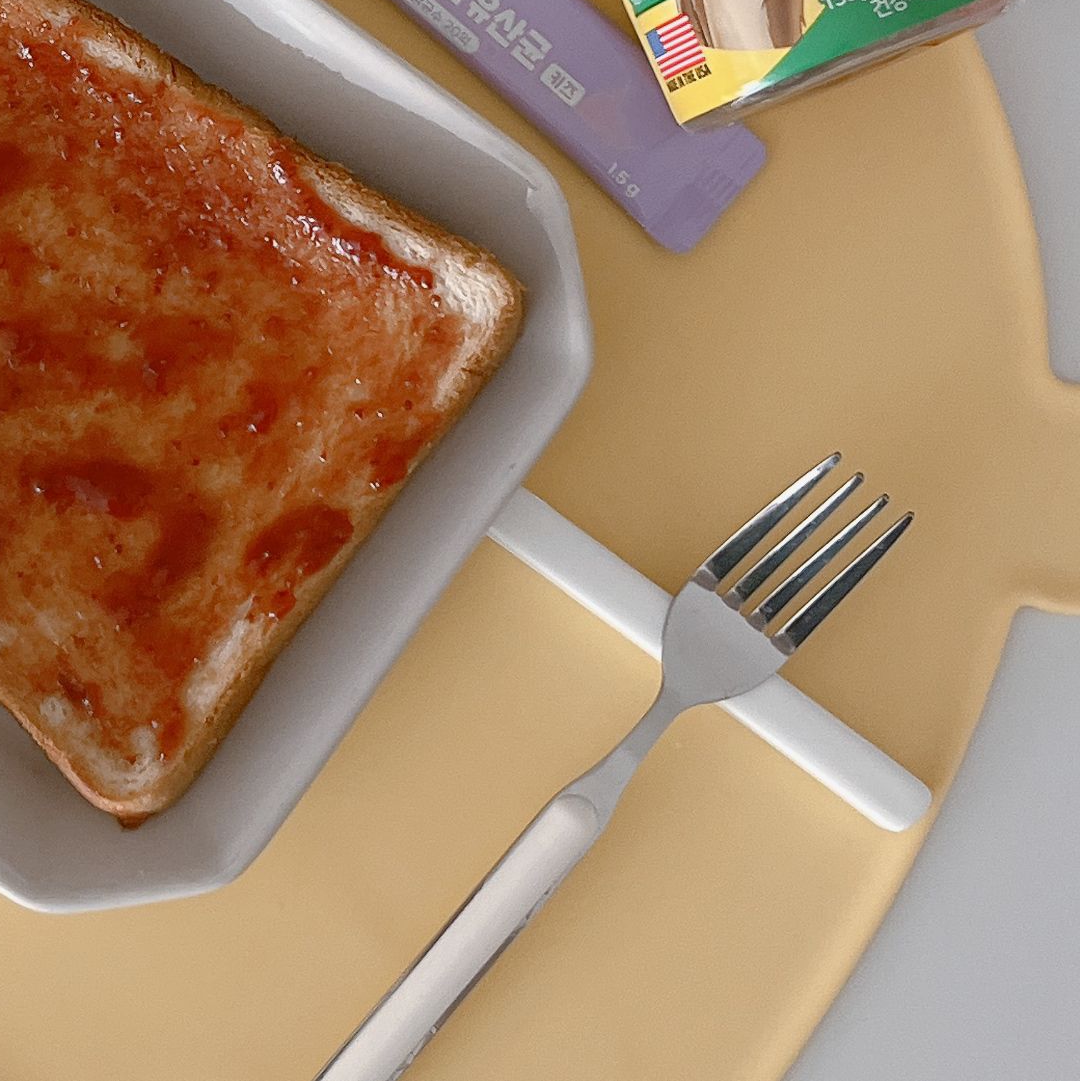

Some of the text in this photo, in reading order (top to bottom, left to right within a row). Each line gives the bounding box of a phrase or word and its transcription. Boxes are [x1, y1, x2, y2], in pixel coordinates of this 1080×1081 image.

[550, 69, 580, 101] 키즈
[607, 162, 641, 198] 1.5 g
